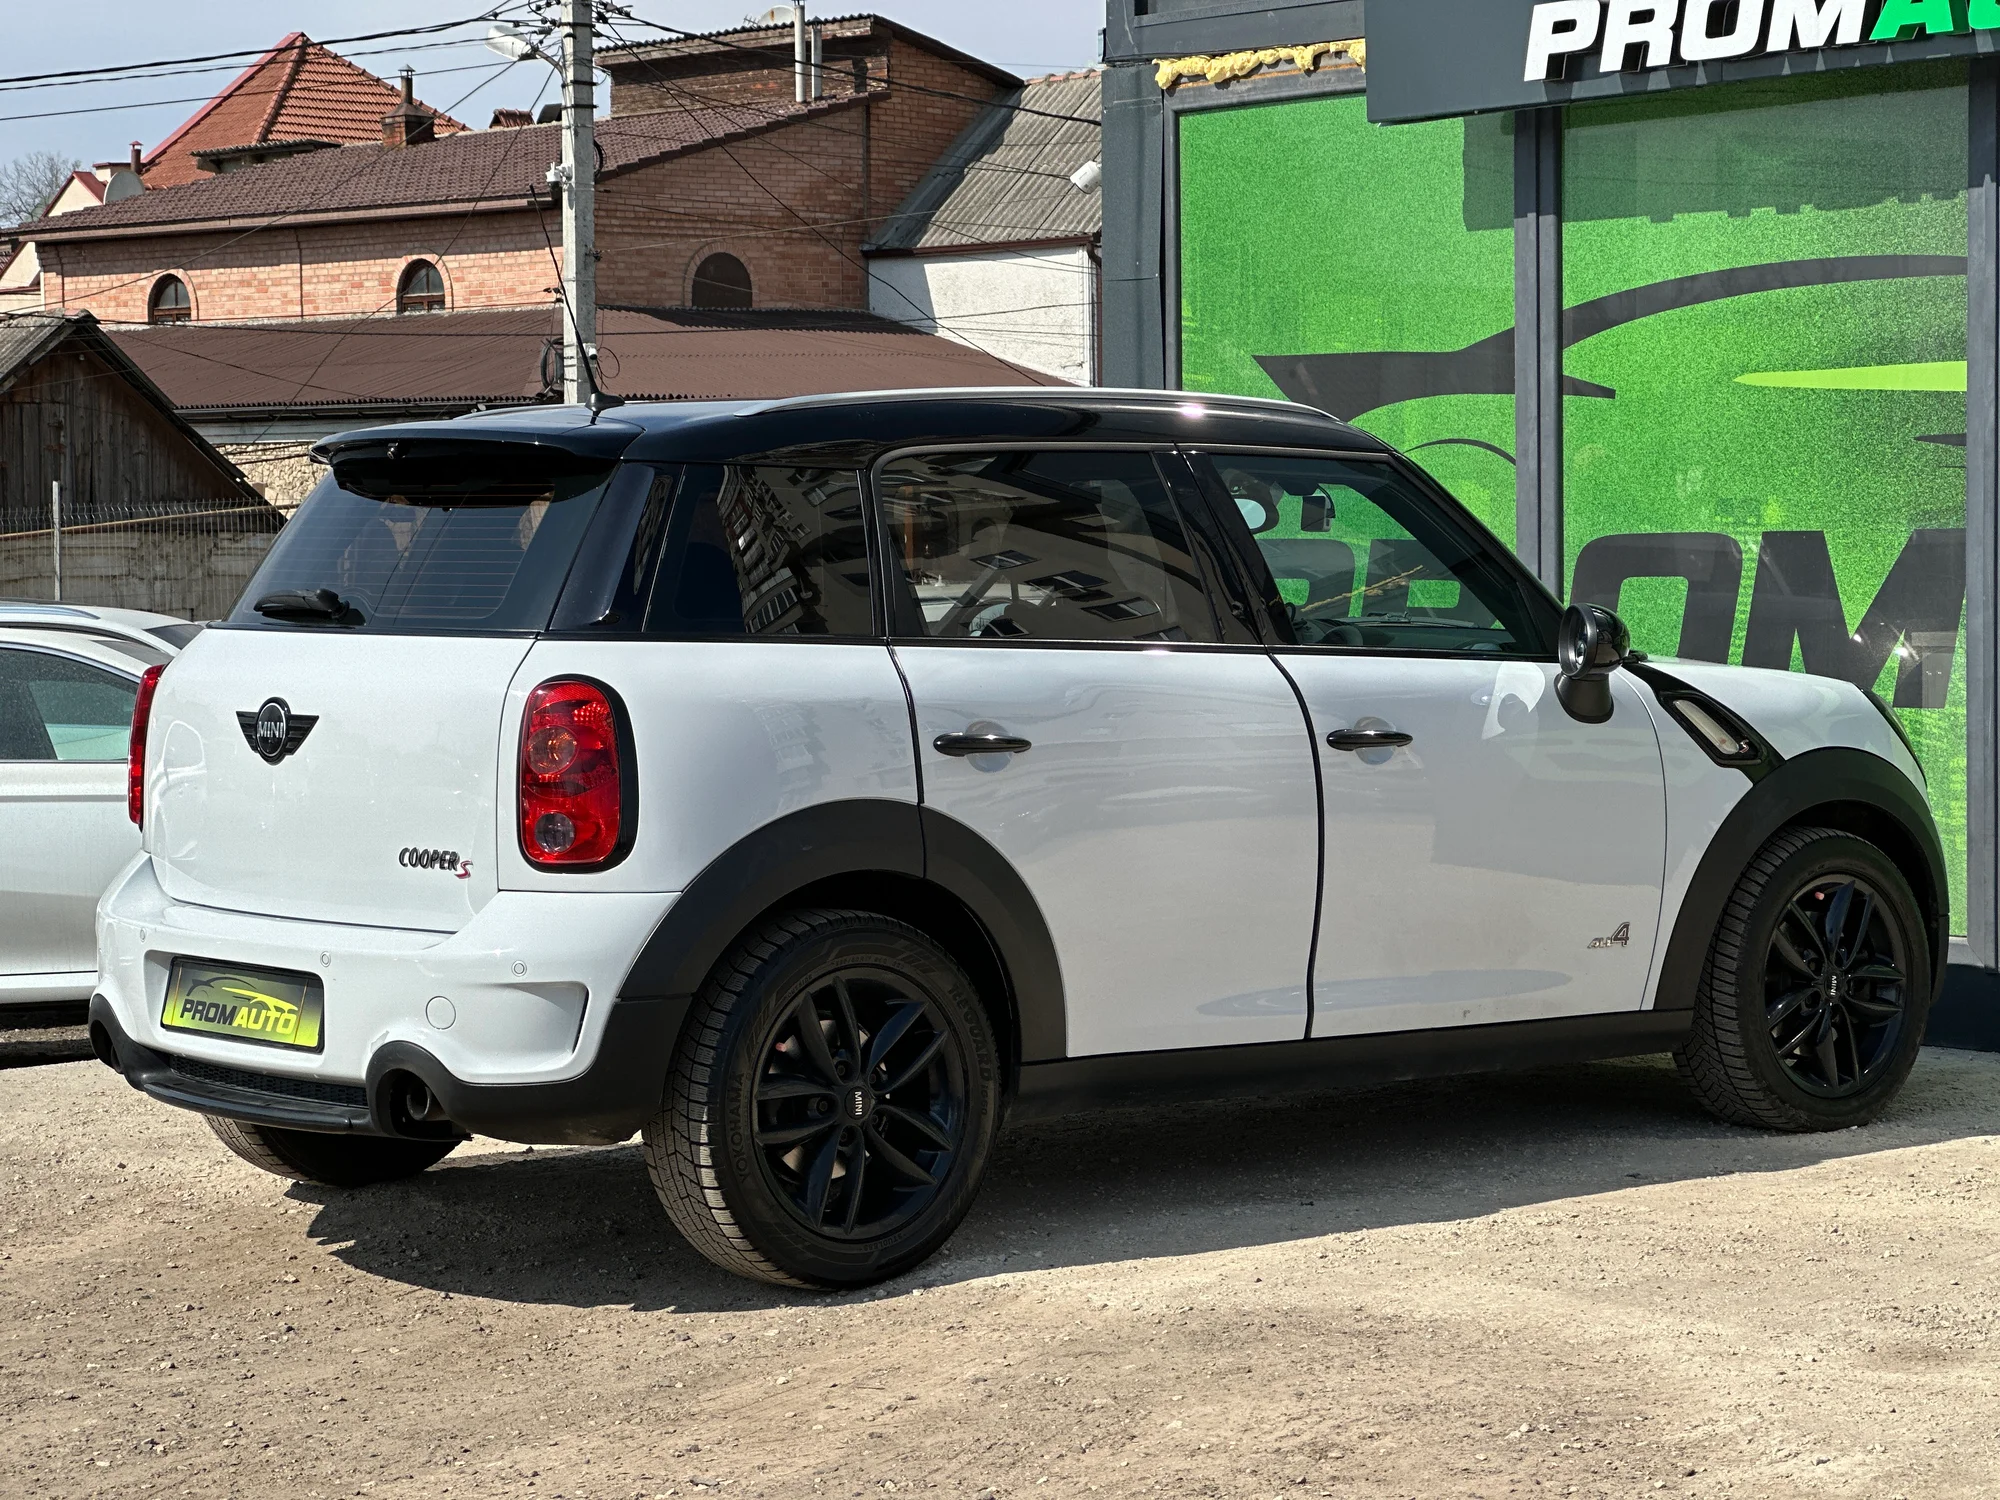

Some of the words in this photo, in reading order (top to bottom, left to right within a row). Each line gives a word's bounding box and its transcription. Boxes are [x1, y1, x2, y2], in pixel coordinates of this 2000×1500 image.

[258, 721, 284, 738] MINI
[399, 847, 460, 871] COOPER
[454, 860, 473, 879] S
[180, 998, 298, 1035] PROMAUTO
[854, 1091, 863, 1116] MINI
[726, 1071, 749, 1184] YOKOHAMA
